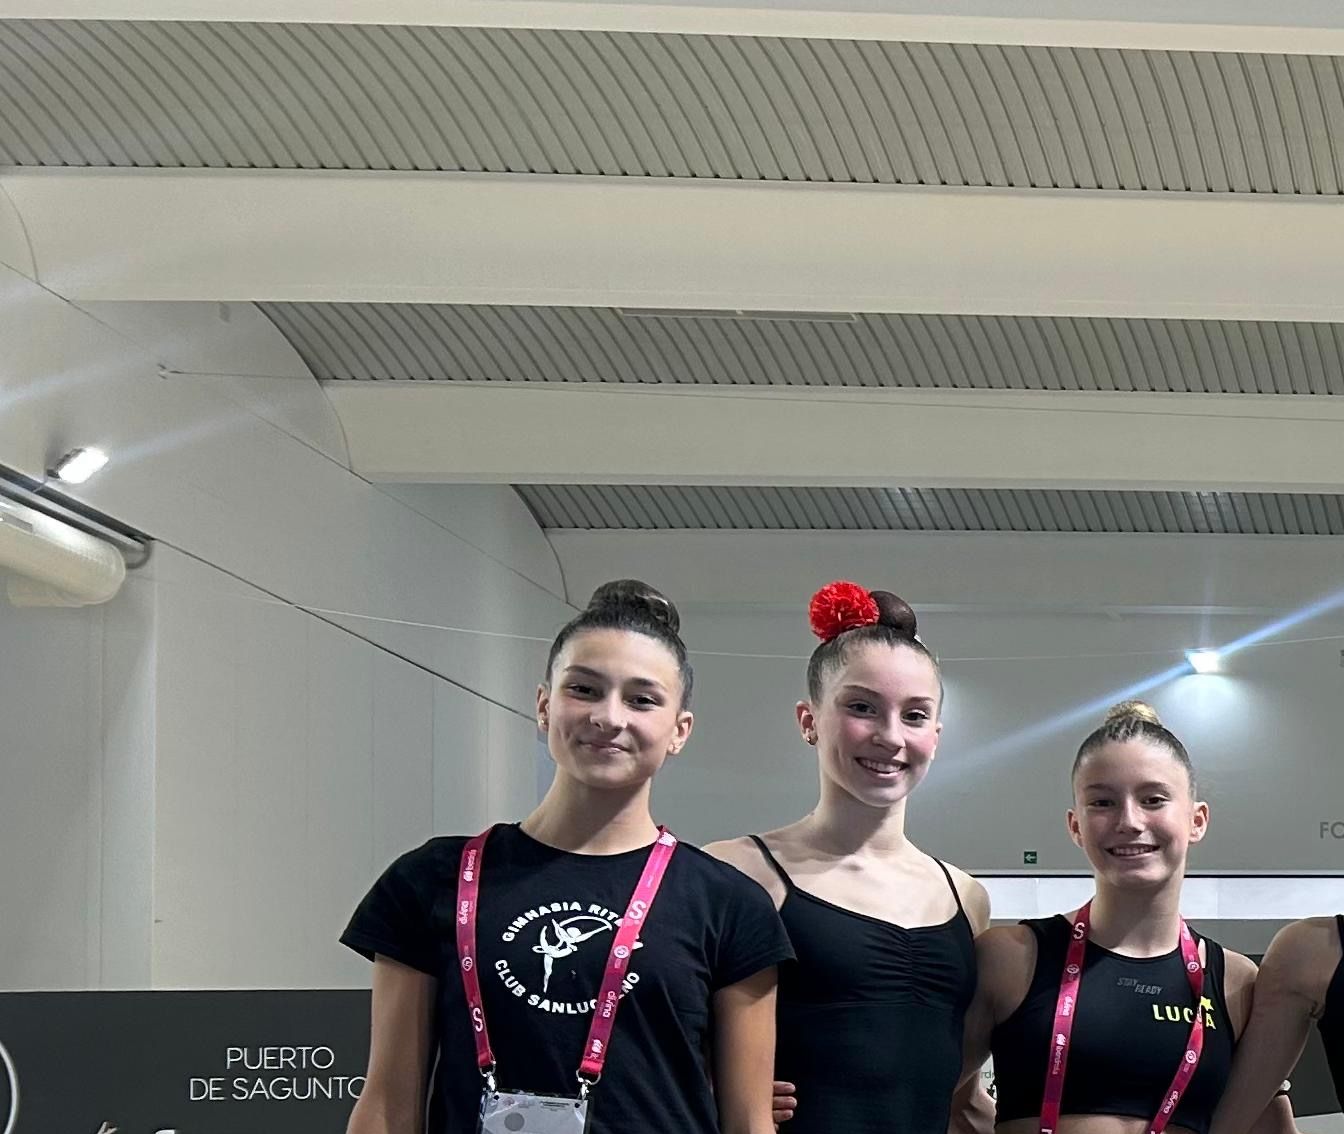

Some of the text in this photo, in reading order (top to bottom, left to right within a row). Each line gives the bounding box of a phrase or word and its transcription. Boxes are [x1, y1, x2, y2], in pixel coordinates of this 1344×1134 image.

[502, 901, 582, 942] GIMNASIA
[495, 959, 527, 998] CLUB
[1152, 1003, 1217, 1030] LUCA
[226, 1046, 335, 1070] PUERTO
[189, 1076, 367, 1101] DE SAGUNTO
